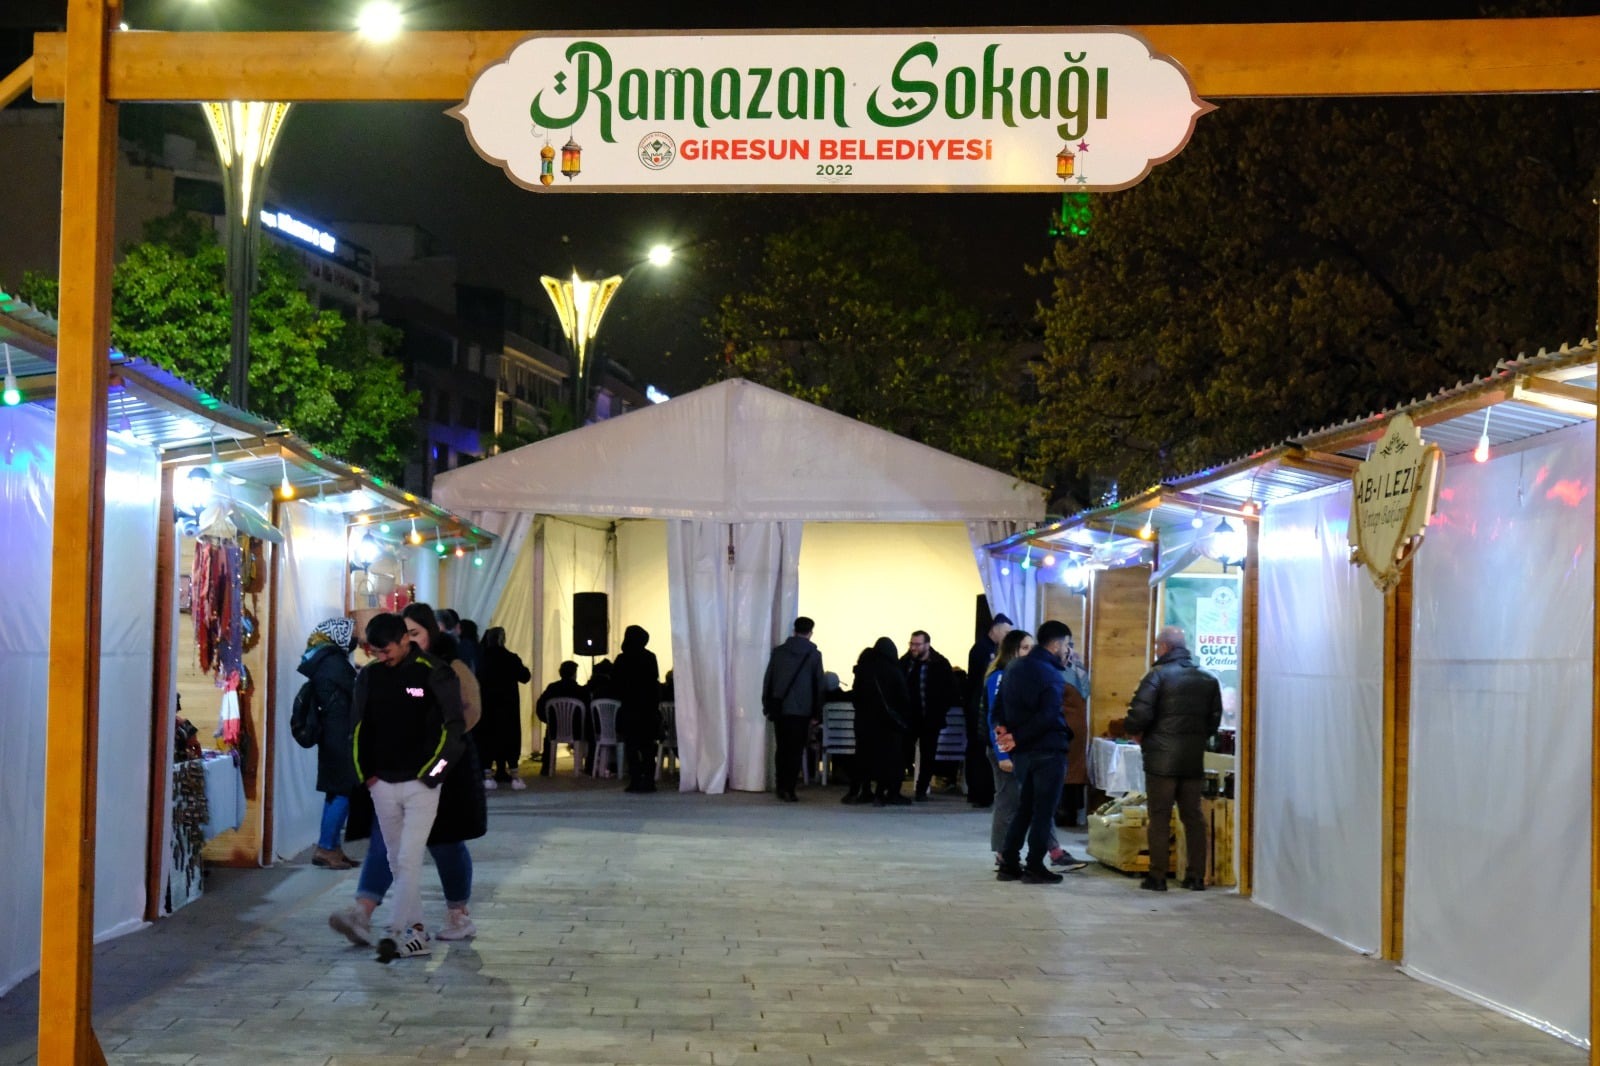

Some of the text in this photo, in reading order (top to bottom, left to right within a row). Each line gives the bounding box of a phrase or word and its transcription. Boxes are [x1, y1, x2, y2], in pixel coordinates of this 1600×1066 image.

[530, 41, 1109, 143] Ramazan Sokağı
[680, 139, 810, 161] GİRESUN
[819, 139, 993, 161] BELEDİYESİ
[816, 164, 853, 176] 2022
